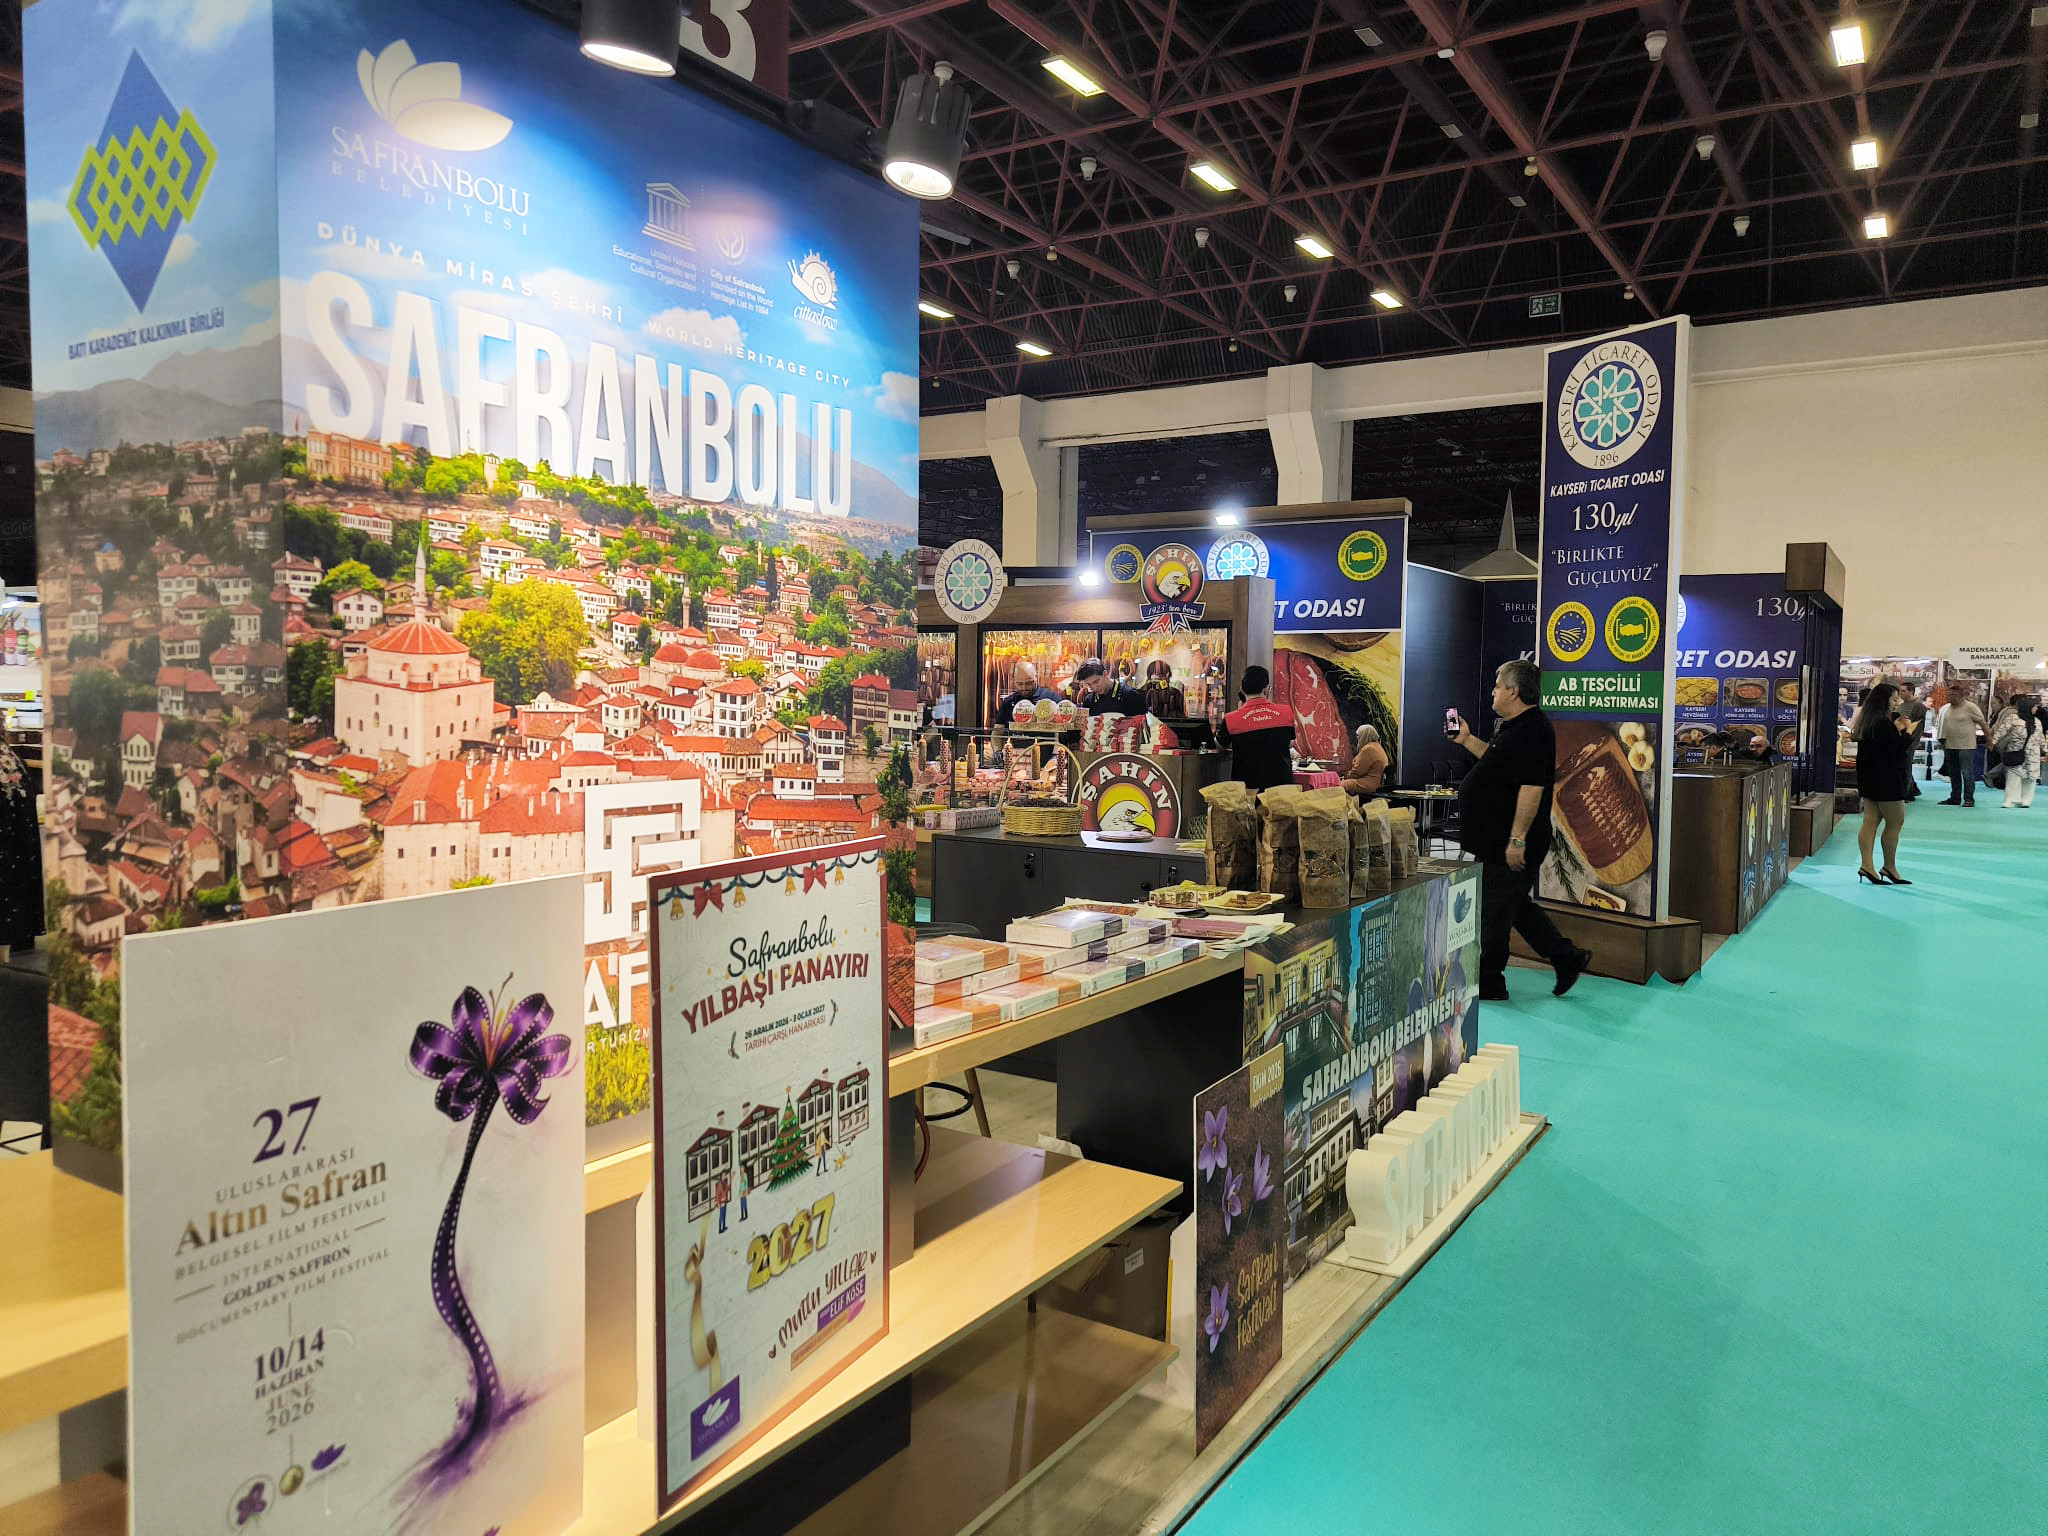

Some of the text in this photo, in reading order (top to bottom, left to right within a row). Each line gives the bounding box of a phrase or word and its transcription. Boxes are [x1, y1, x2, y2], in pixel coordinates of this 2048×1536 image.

[331, 126, 530, 217] SAFRANBOLU
[316, 221, 623, 323] DÜNYA MİRAS ŞEHRİ
[732, 275, 766, 295] Safranbolu
[68, 341, 88, 361] BATI
[139, 317, 188, 345] KALKINMA
[793, 300, 838, 331] cittaslow
[648, 319, 850, 388] WORLD HERITAGE CITY
[304, 271, 853, 518] SAFRANBOLU
[1636, 373, 1660, 440] ODASI
[1593, 451, 1619, 467] 1896
[1631, 468, 1665, 486] ODASI
[1293, 597, 1366, 619] ODASI
[1558, 673, 1641, 692] AB TESCİLLİ
[1714, 649, 1797, 669] ODASI
[1542, 692, 1659, 709] KAYSERİ PASTIRMASI
[1081, 761, 1172, 809] ŞAHİN
[727, 914, 836, 978] Safranbolu
[681, 952, 869, 1035] YILBAŞI PANAYIRI
[752, 1023, 775, 1037] ARALIK
[1302, 986, 1457, 1113] SAFRANBOLU BELEDİYESİ
[1267, 1059, 1283, 1084] 2026
[214, 1146, 356, 1204] ULUSLARARASI
[1345, 1043, 1521, 1265] SAFRANBOLU
[174, 1191, 387, 1281] BELGESEL FİLM FESTİVALİ
[175, 1160, 388, 1257] Altın Safran
[222, 1227, 350, 1287] INTERNATIONAL
[746, 1191, 836, 1293] 2027
[175, 1247, 391, 1345] DOCUMENTARY FILM FESTIVAL
[223, 1244, 353, 1307] GOLDEN SAFFRON
[824, 1250, 868, 1295] YILLAR
[1237, 1239, 1279, 1310] Safran
[1237, 1279, 1279, 1353] Festivali
[254, 1357, 325, 1401] HAZİRAN
[255, 1326, 325, 1382] 10/14
[265, 1379, 313, 1415] JUNE
[265, 1397, 315, 1436] 2026
